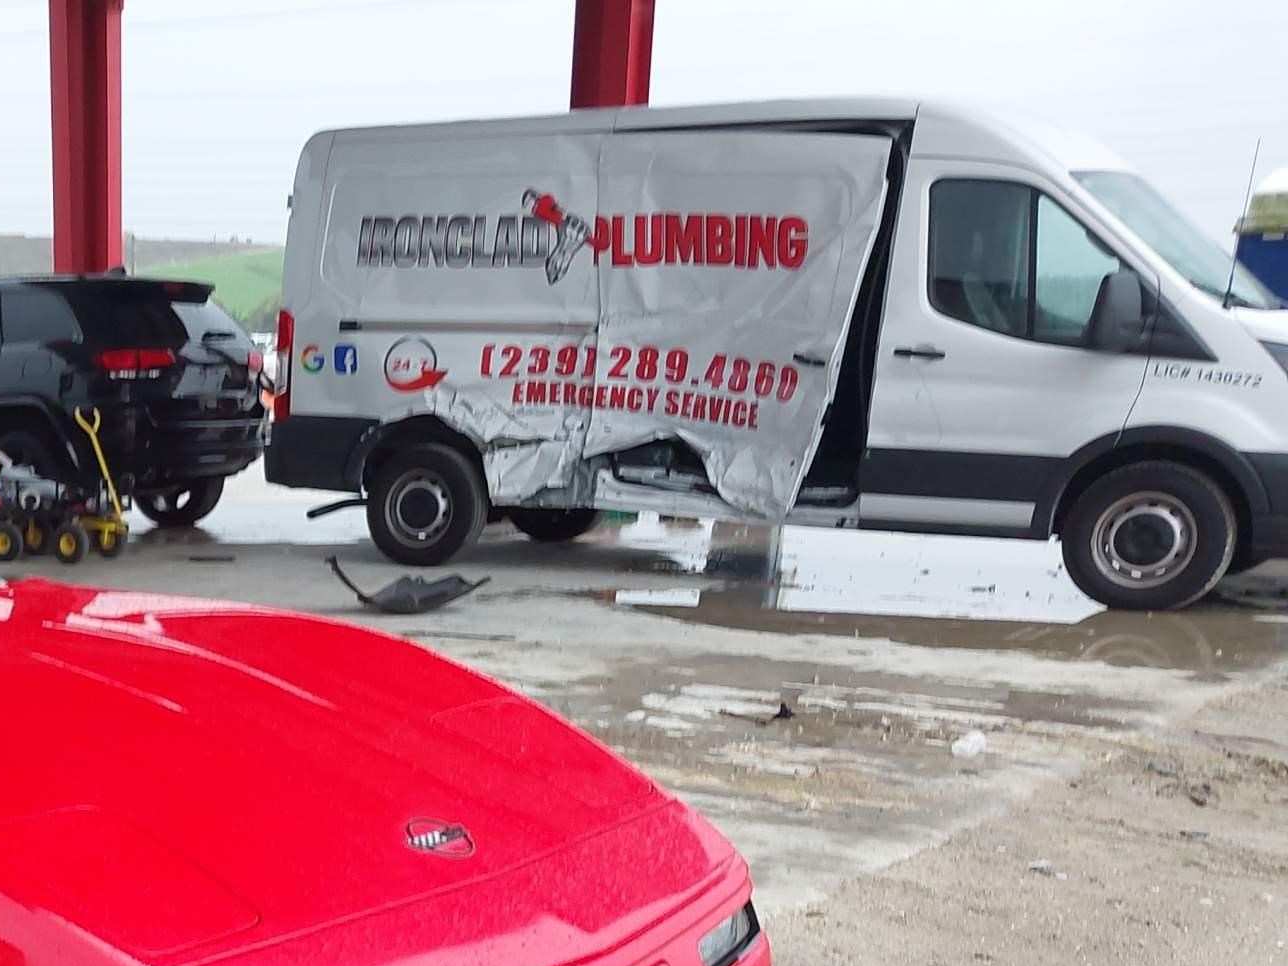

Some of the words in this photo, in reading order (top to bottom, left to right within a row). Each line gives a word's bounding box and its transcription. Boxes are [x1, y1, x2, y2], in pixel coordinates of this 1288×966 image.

[356, 214, 550, 269] IRONCLAD
[592, 212, 809, 270] PLUMBING
[480, 343, 597, 379] (239)
[607, 344, 799, 403] 289.4860
[1154, 363, 1191, 378] LIC#
[1198, 368, 1263, 388] 1430272
[511, 380, 659, 415] EMERGENCY
[664, 388, 759, 430] SERVICE
